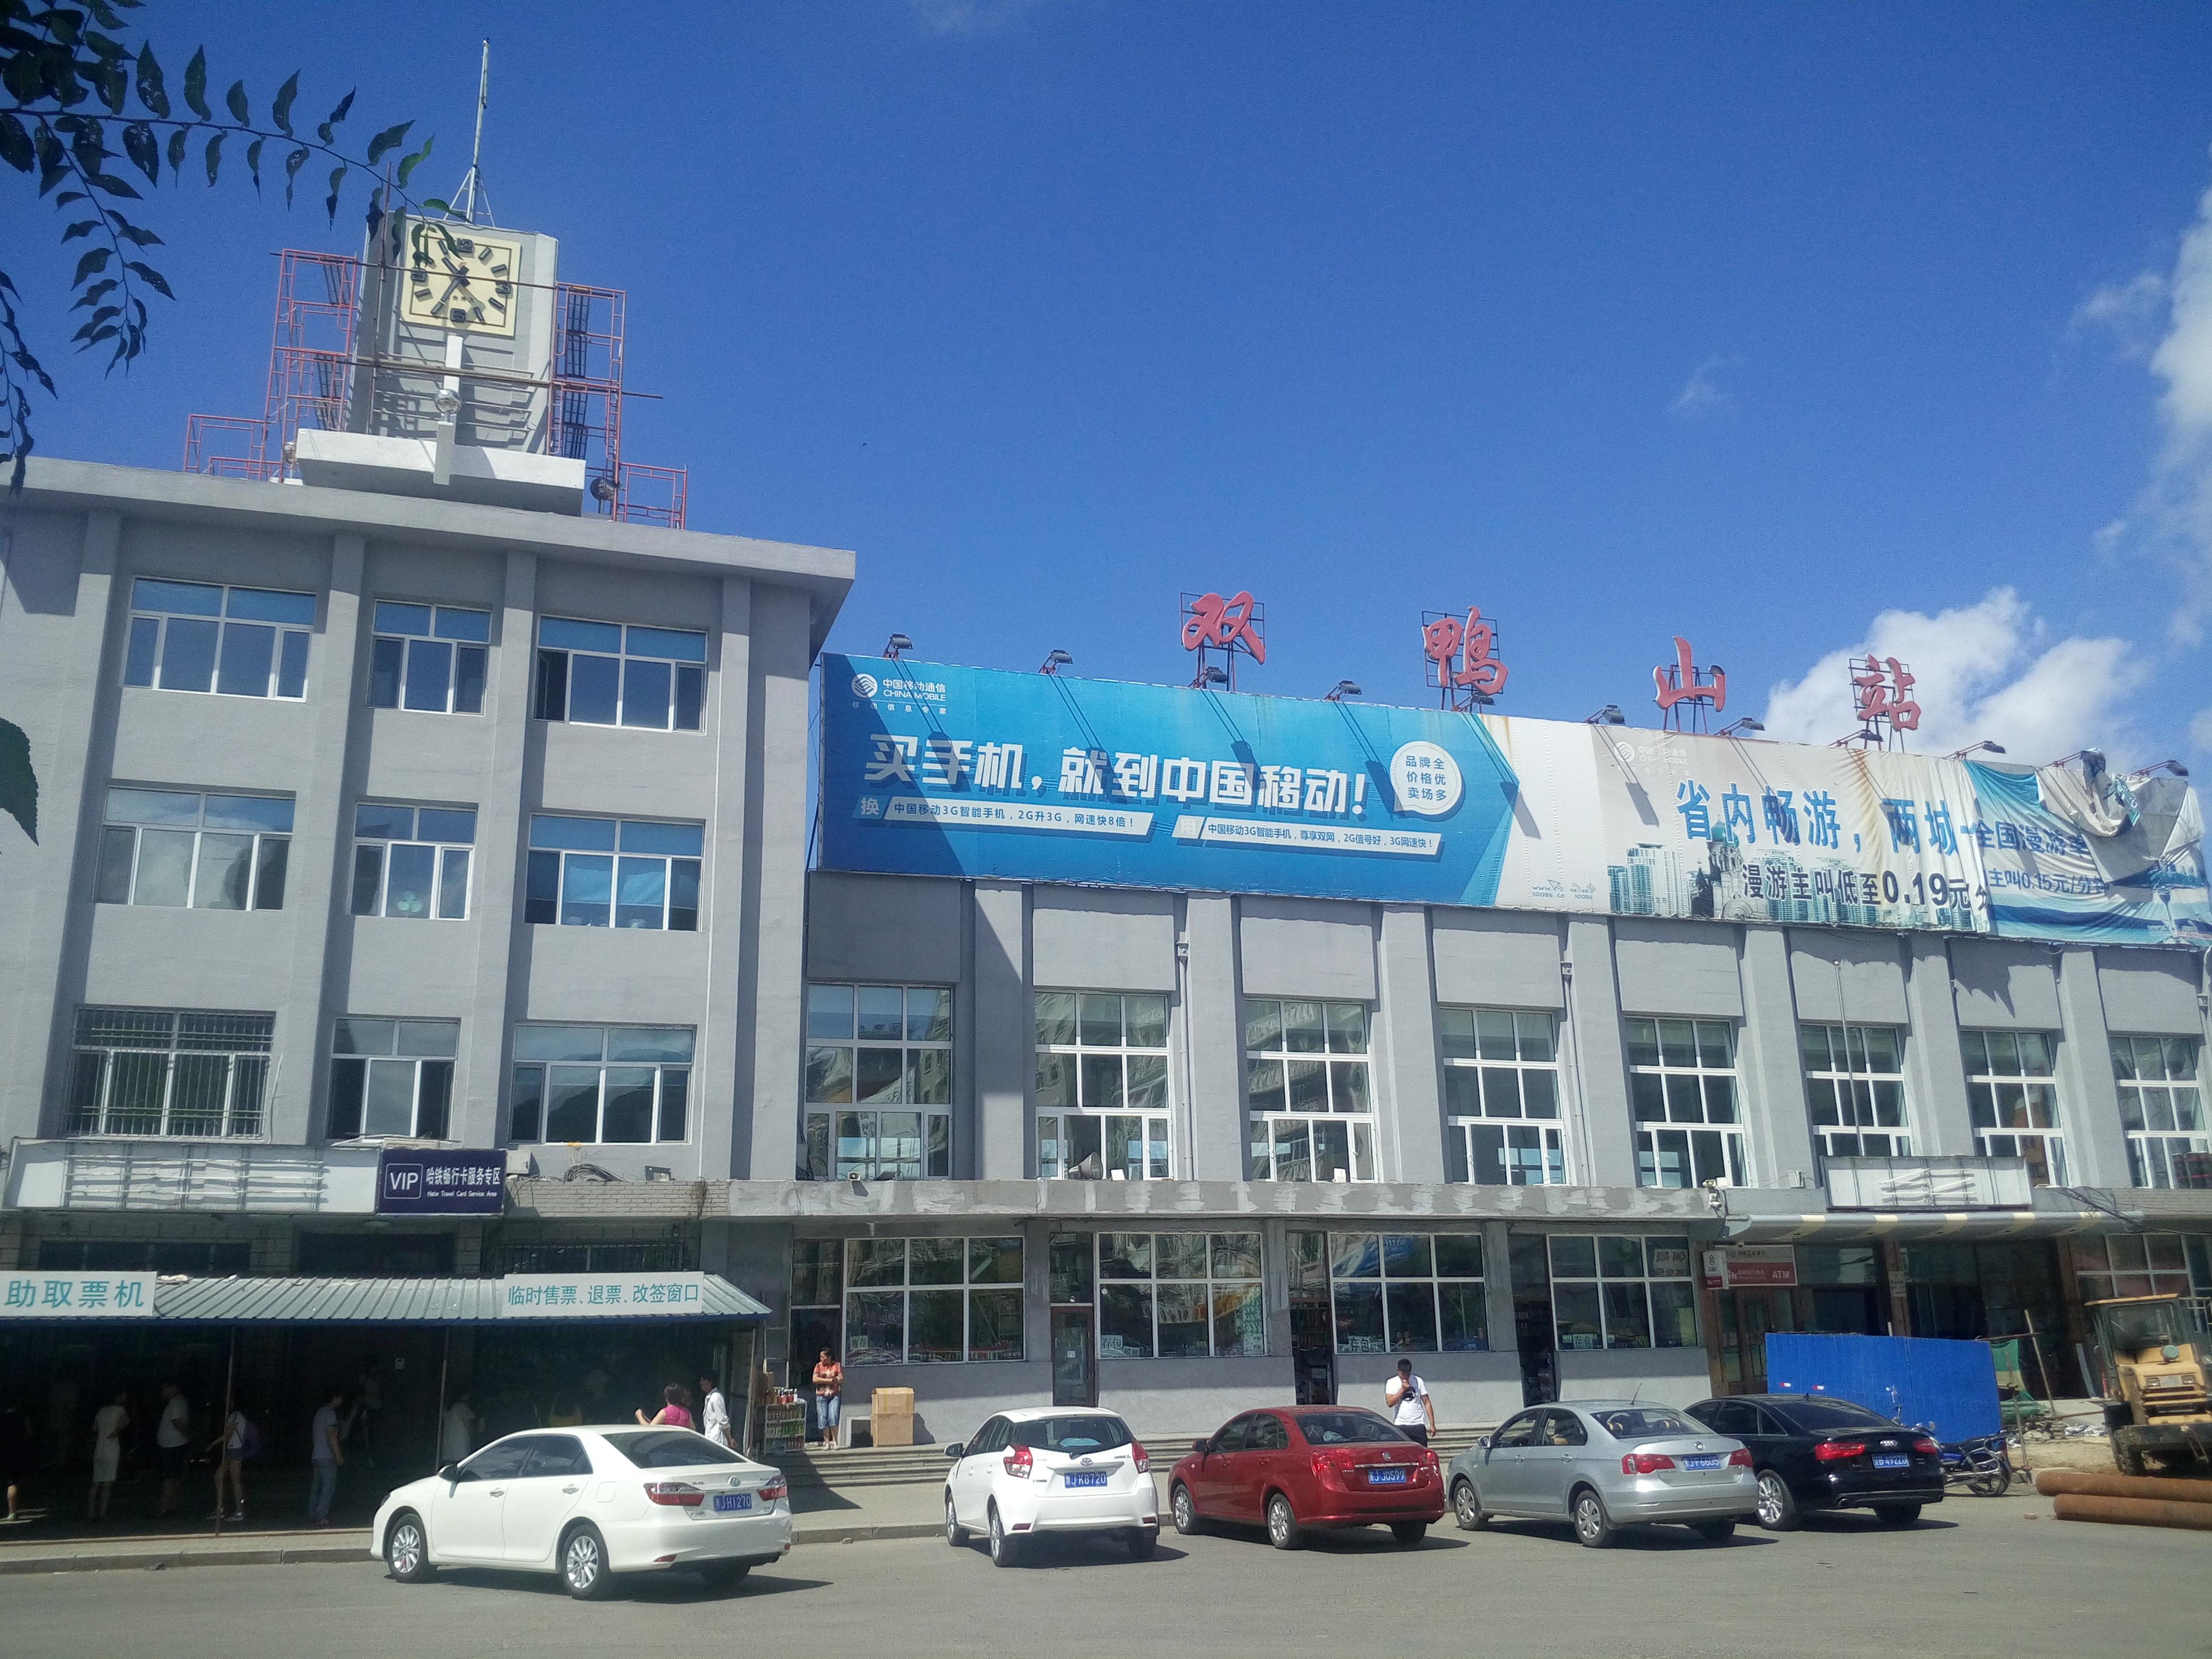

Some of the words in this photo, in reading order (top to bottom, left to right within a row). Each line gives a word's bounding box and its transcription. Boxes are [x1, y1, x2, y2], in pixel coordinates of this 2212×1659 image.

[883, 678, 946, 693] 中国移动通信
[883, 689, 912, 699] CHINA
[914, 692, 946, 701] MOBILE
[852, 701, 946, 715] 移动信息专家
[1406, 755, 1445, 769] 品牌全
[1406, 771, 1446, 785] 价格优
[1407, 786, 1447, 801] 卖场多
[860, 797, 879, 816] 换
[389, 1171, 418, 1191] VIP
[425, 1166, 501, 1186] 哈铁畅行卡服务专区
[1772, 1270, 1790, 1279] ATM
[4, 1279, 144, 1309] 助取票机
[1101, 1337, 1121, 1350] 存包
[1350, 1337, 1370, 1352] 存包
